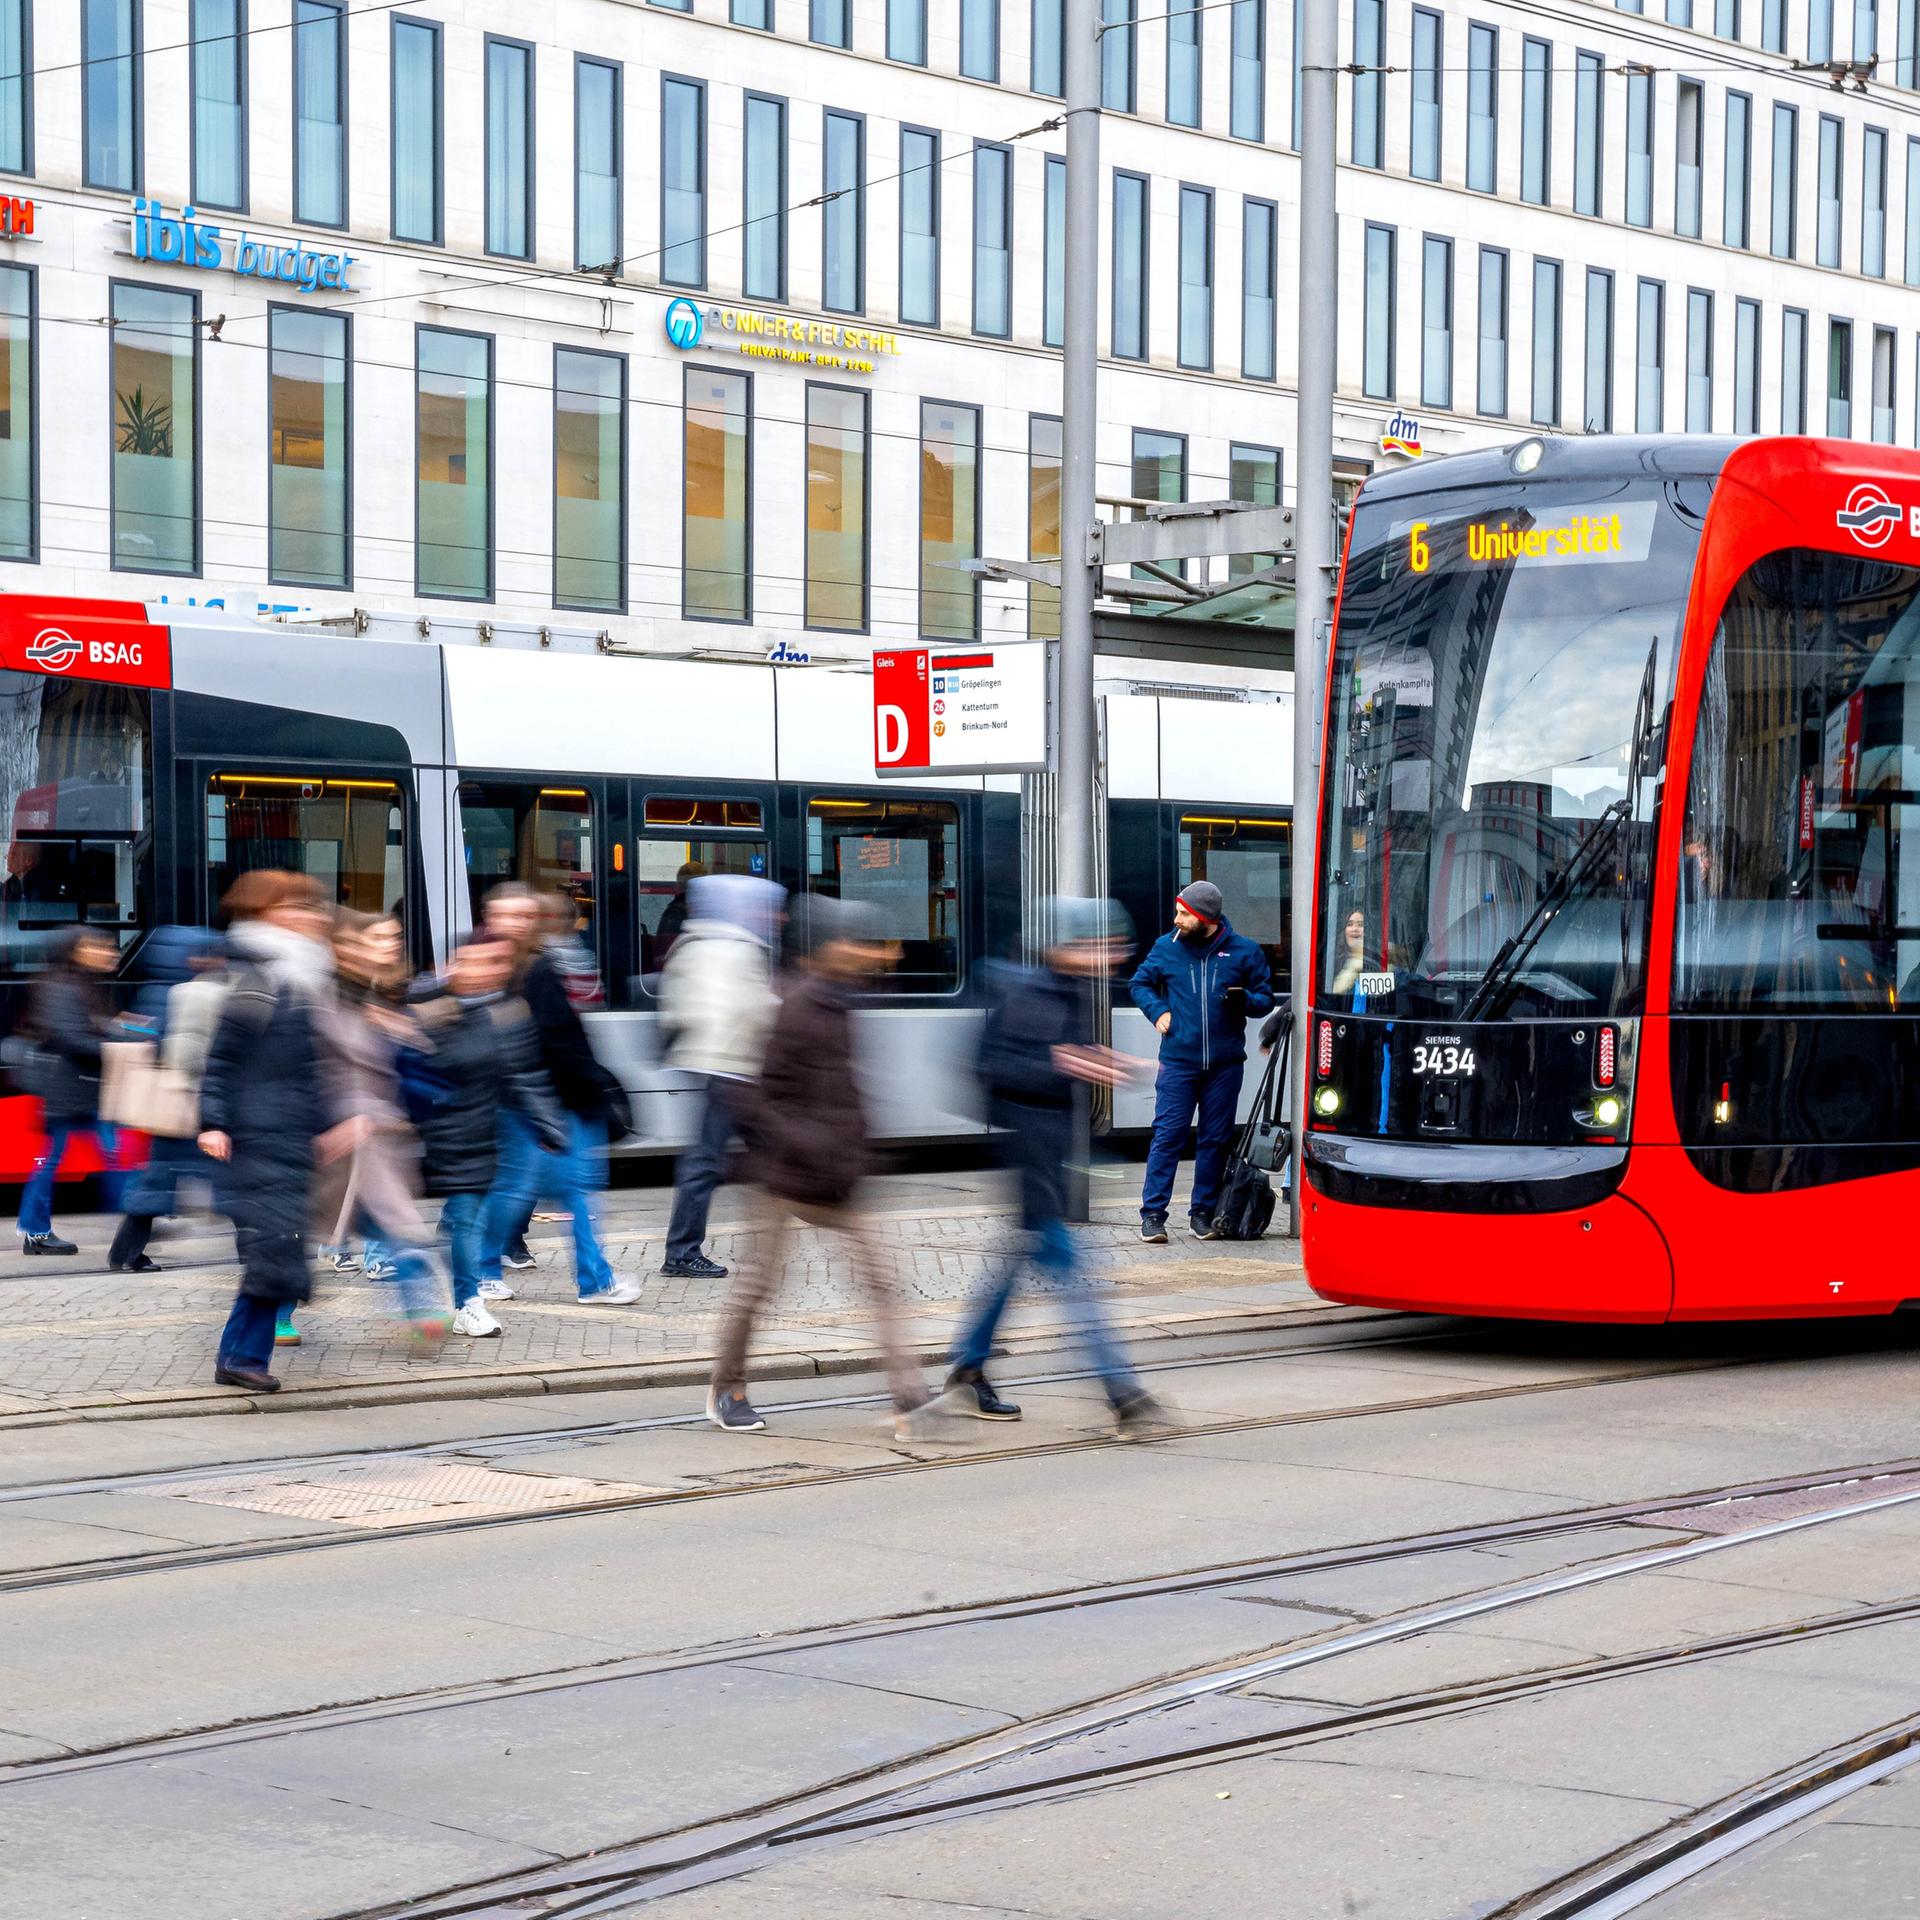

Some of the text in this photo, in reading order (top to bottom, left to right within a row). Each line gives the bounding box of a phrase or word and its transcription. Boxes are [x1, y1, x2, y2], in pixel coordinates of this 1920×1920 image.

[131, 197, 354, 293] ibis budget
[791, 321, 805, 342] &
[1390, 411, 1419, 440] dm
[1410, 513, 1623, 573] 6 Universität
[89, 641, 143, 666] BSAG
[770, 641, 809, 663] dm
[876, 657, 895, 668] Gleis
[934, 680, 944, 691] 10
[961, 679, 1002, 690] Gröpelingen
[934, 702, 999, 713] 26 Kattenturm
[877, 704, 909, 763] D
[934, 720, 1008, 734] 27 Brinkum-Nord
[1361, 977, 1393, 995] 6009
[1425, 1036, 1461, 1045] SIEMENS
[1412, 1046, 1476, 1076] 3434
